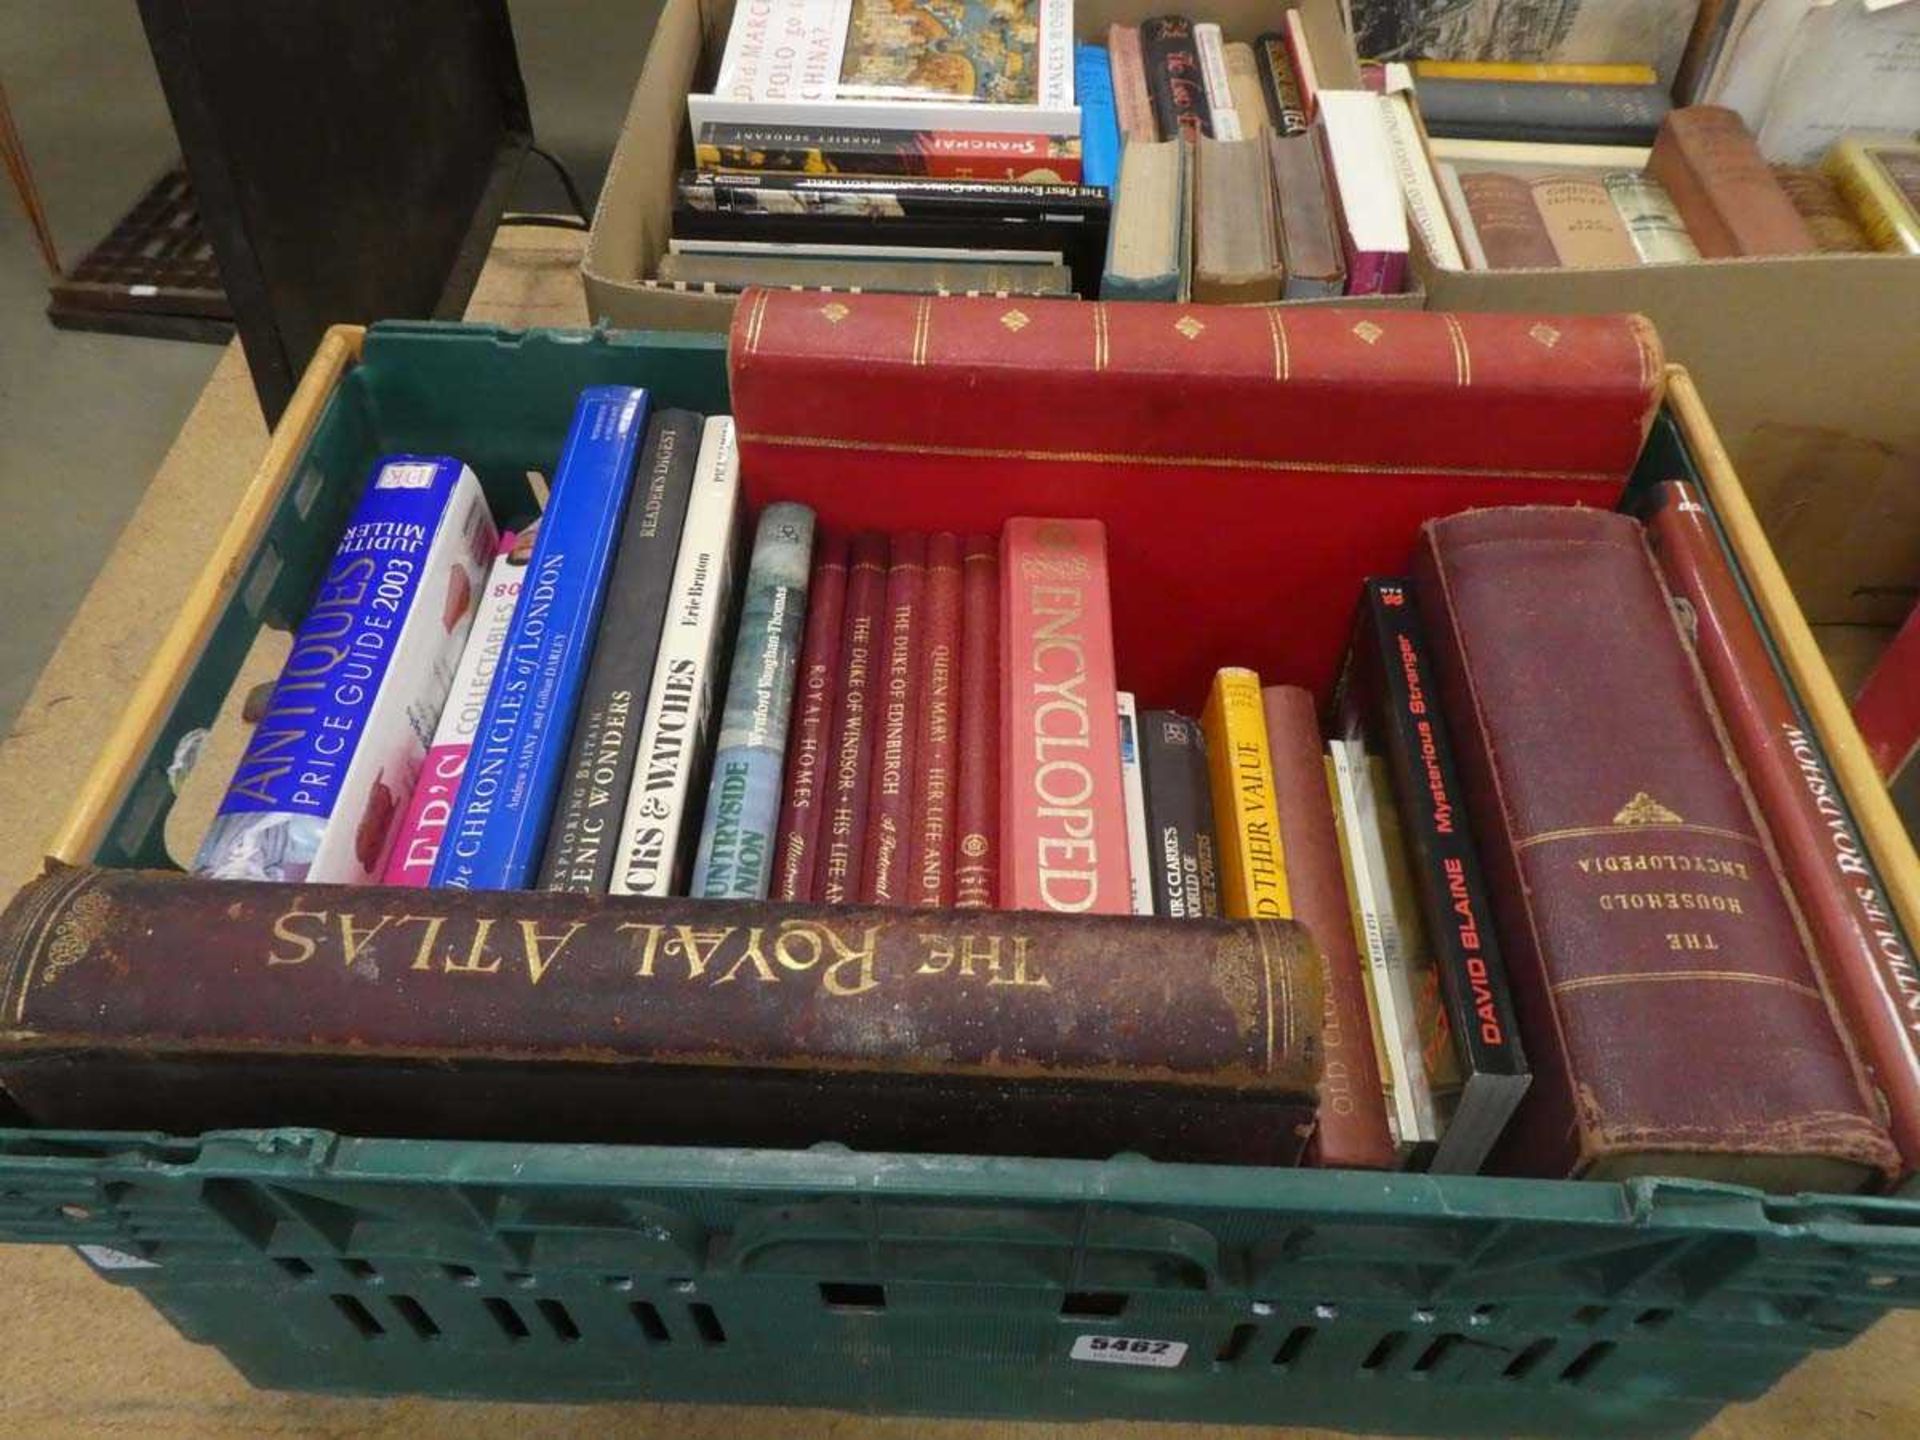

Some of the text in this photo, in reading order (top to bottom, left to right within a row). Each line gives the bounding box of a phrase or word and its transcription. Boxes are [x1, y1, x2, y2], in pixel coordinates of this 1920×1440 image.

[744, 0, 772, 57] MARC
[767, 47, 797, 99] POLO
[804, 27, 831, 101] CHINA?
[735, 130, 882, 146] HARRIET SERGEANT
[932, 138, 1036, 155] SHANGHAI
[988, 181, 1044, 196] EMPEROR
[1047, 184, 1077, 197] FIRST
[1080, 185, 1105, 198] THE
[337, 539, 425, 554] JUDITH
[343, 522, 427, 542] MILLER
[681, 553, 711, 627] Eric Bruton
[895, 605, 911, 630] THE
[230, 558, 376, 805] ANTIQUES
[292, 560, 415, 807] PRICE GUIDE 2003
[891, 634, 911, 676] DUKE
[930, 644, 953, 697] QUEEN
[804, 664, 827, 733] ROYAL
[888, 678, 908, 698] OF
[446, 553, 566, 892] he CHRONICLES of LONDON
[748, 690, 771, 748] Wynford
[928, 699, 948, 745] MARY
[520, 734, 537, 771] SAINT
[589, 689, 632, 809] WONDERS
[624, 658, 697, 893] CKS & WATCHES
[793, 738, 818, 809] HOMES
[824, 616, 872, 905] THE DUKE OF WINDSOR HIS LIFE AN
[881, 702, 906, 796] EDINBURGH
[1031, 586, 1098, 914] ENCYCLOPED
[551, 713, 600, 892] EXPLORING BRITAIN
[926, 767, 946, 806] HER
[1238, 742, 1267, 814] VALUE
[1781, 722, 1871, 883] ROADSHOW
[705, 761, 750, 897] UNTRYSIDE
[924, 807, 946, 842] LIFE
[1399, 634, 1503, 1044] DAVID BLAINE Mysterious Stranger
[921, 849, 944, 890] AND
[1248, 821, 1278, 891] THEIR
[1577, 855, 1751, 881] ENCYCLOPEDIA
[1600, 892, 1744, 915] HOUSEHOLD
[268, 910, 1054, 998] THE ROYAL ATLAS
[1666, 933, 1719, 951] THE
[1321, 1059, 1354, 1116] OLD
[1089, 1338, 1171, 1355] 5462
